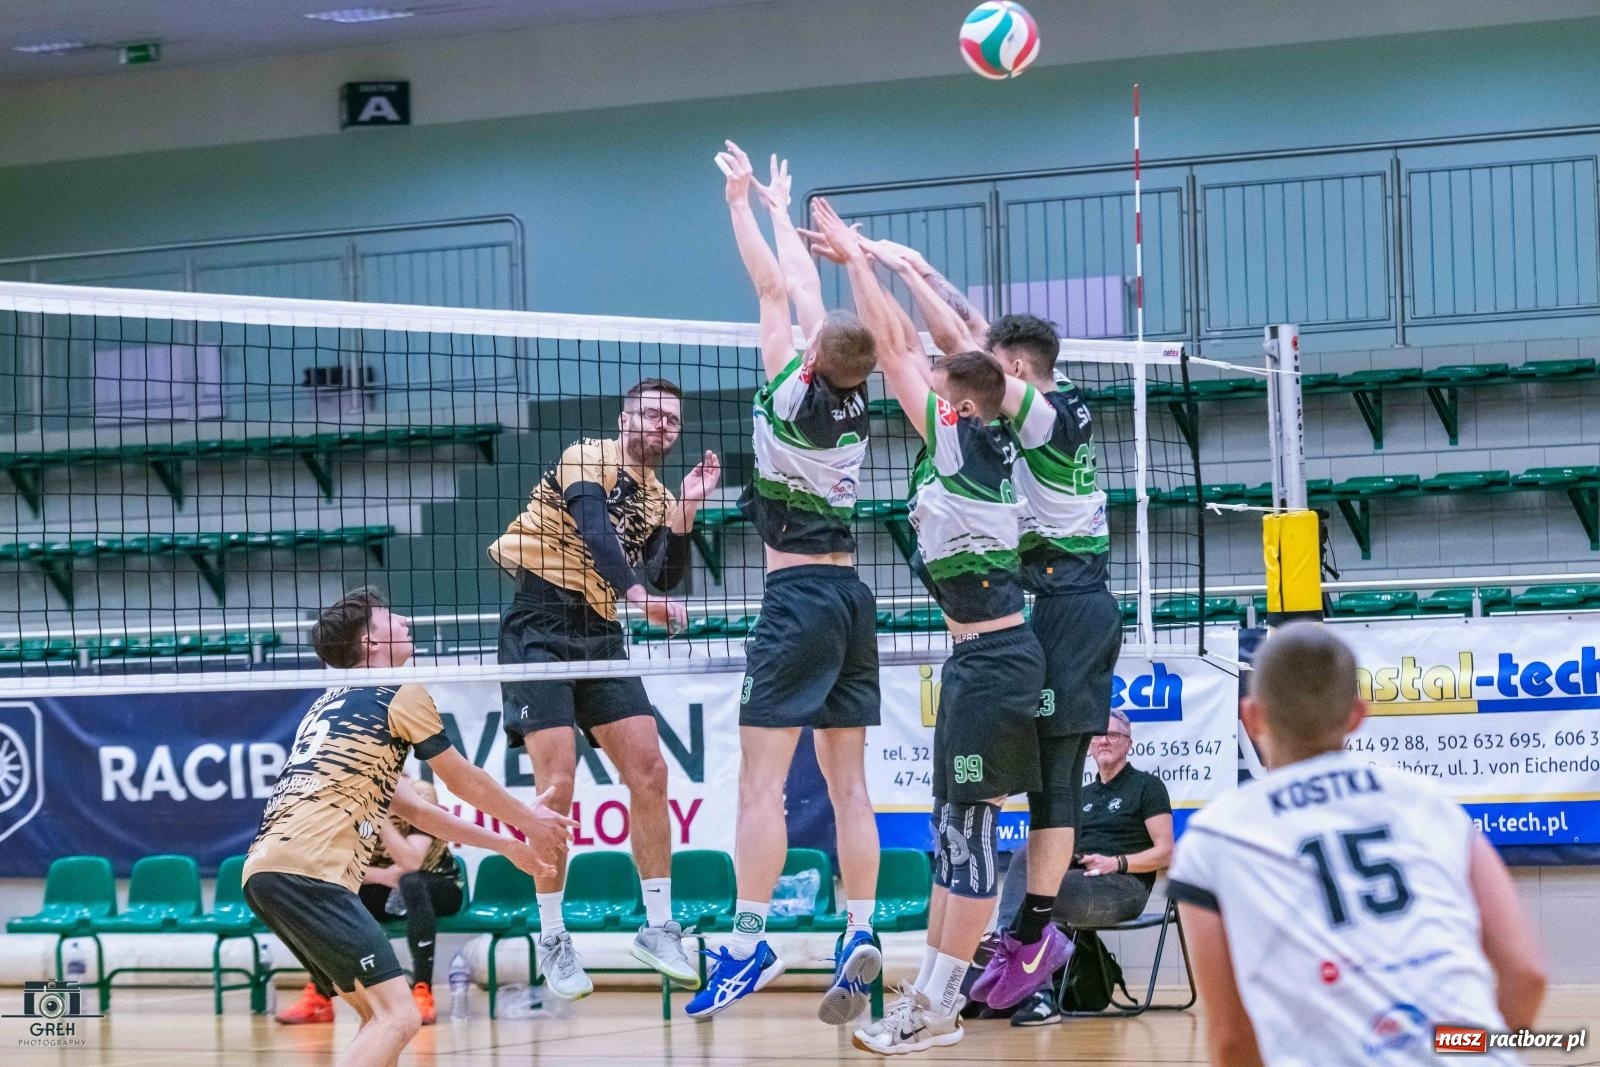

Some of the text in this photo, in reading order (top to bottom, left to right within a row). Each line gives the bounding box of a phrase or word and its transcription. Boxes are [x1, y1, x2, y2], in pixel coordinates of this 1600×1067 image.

[357, 96, 401, 122] A
[1163, 349, 1179, 357] netex
[1355, 646, 1600, 702] nstal-tech
[1160, 741, 1190, 757] 363
[1195, 740, 1222, 756] 647
[1380, 737, 1400, 752] 92
[1405, 735, 1429, 752] 88,
[1438, 735, 1468, 751] 502
[1473, 733, 1504, 749] 632
[1509, 732, 1546, 749] 695,
[1554, 730, 1585, 747] 606
[883, 746, 930, 761] tel. 32
[99, 742, 288, 801] RACIB
[954, 754, 983, 784] 99
[1203, 766, 1211, 780] 2
[1448, 759, 1468, 776] ul.
[1472, 759, 1484, 776] J.
[1489, 761, 1519, 774] von
[894, 771, 932, 787] 47-4
[1466, 810, 1569, 837] al-tech.pl
[1299, 823, 1416, 932] 15
